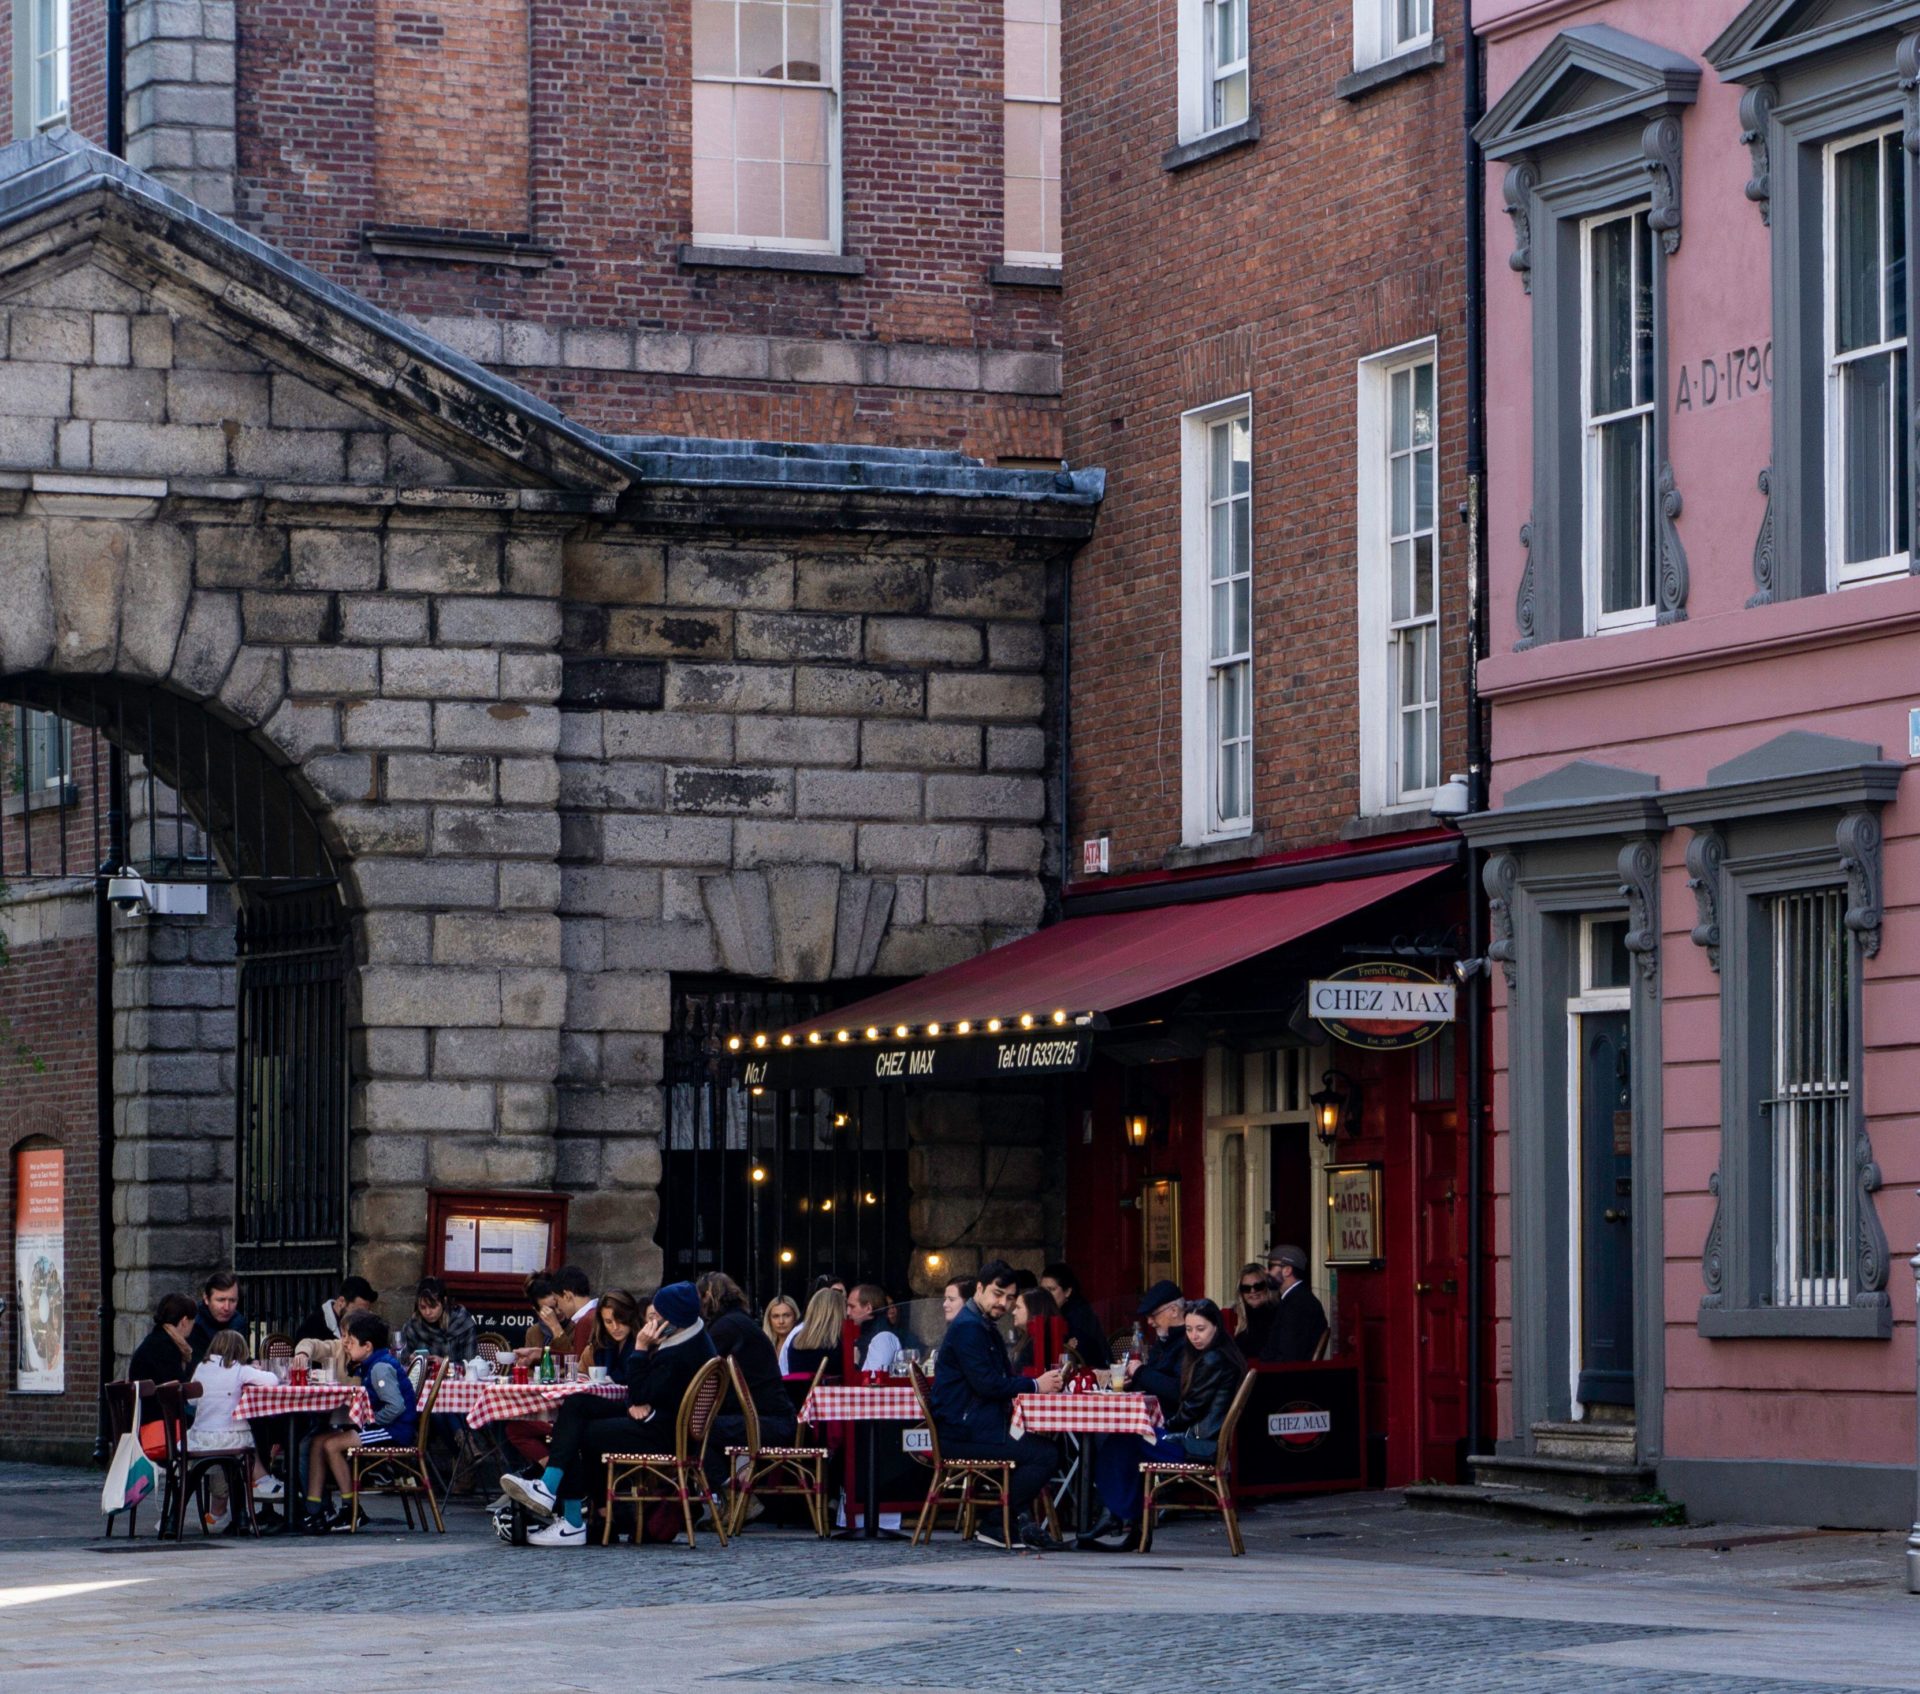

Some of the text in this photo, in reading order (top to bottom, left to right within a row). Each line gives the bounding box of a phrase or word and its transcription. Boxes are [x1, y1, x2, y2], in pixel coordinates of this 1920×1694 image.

[1358, 965, 1388, 977] French
[1315, 988, 1449, 1013] CHEZ MAX
[876, 1050, 936, 1077] CHEZ MAX
[998, 1041, 1078, 1069] Tel: 01 6337215
[1342, 1229, 1369, 1250] BACK
[500, 1315, 535, 1326] JOUR
[1270, 1414, 1328, 1432] CHEZ MAX
[905, 1433, 929, 1447] CH
